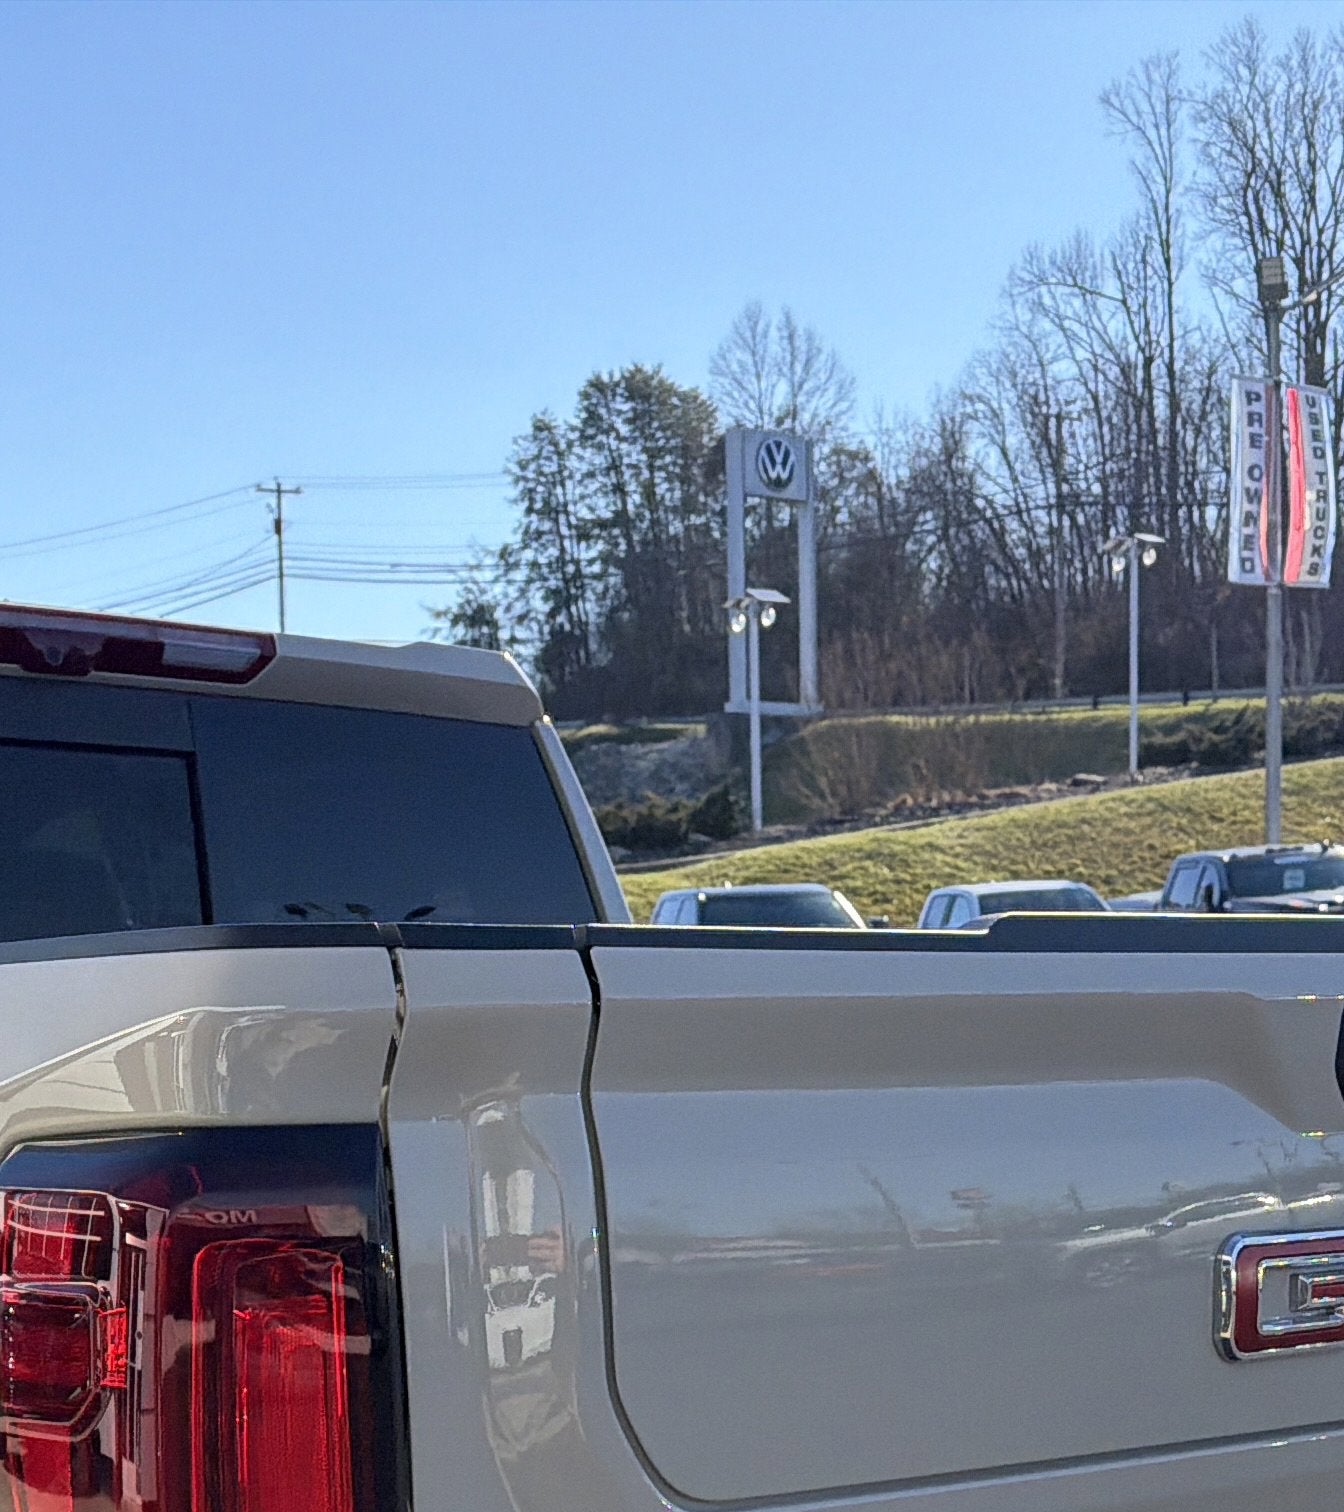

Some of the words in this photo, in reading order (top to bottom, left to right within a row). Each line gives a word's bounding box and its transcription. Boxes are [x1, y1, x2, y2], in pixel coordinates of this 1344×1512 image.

[1244, 390, 1263, 450] PRE
[1304, 395, 1325, 461] USED
[1306, 470, 1328, 577] TRUCKS
